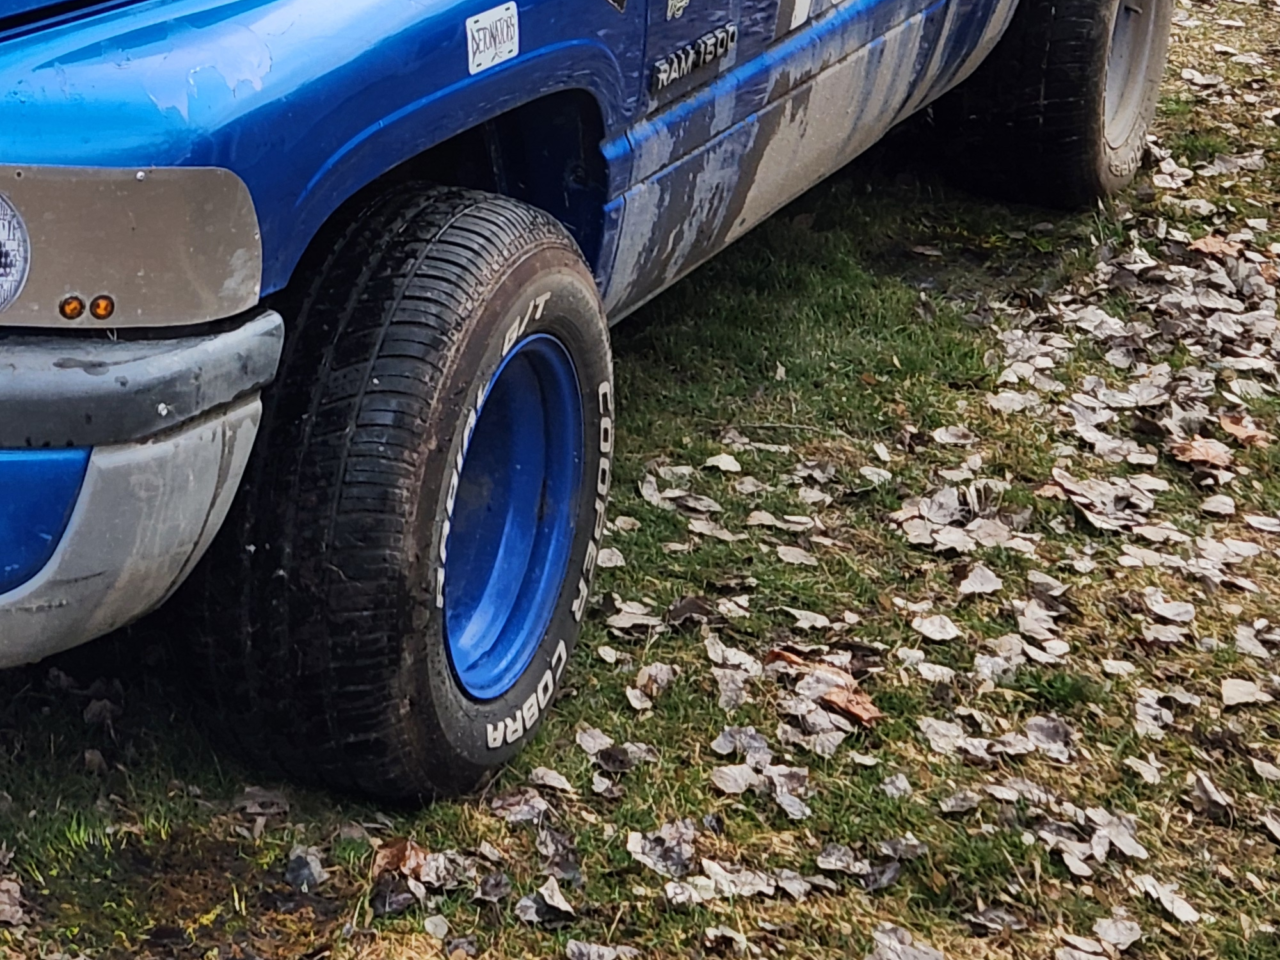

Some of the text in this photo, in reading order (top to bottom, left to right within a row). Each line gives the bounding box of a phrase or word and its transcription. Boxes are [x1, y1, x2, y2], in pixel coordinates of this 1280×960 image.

[655, 44, 696, 90] RAM
[571, 380, 613, 623] COOPER
[485, 638, 568, 749] COBRA
